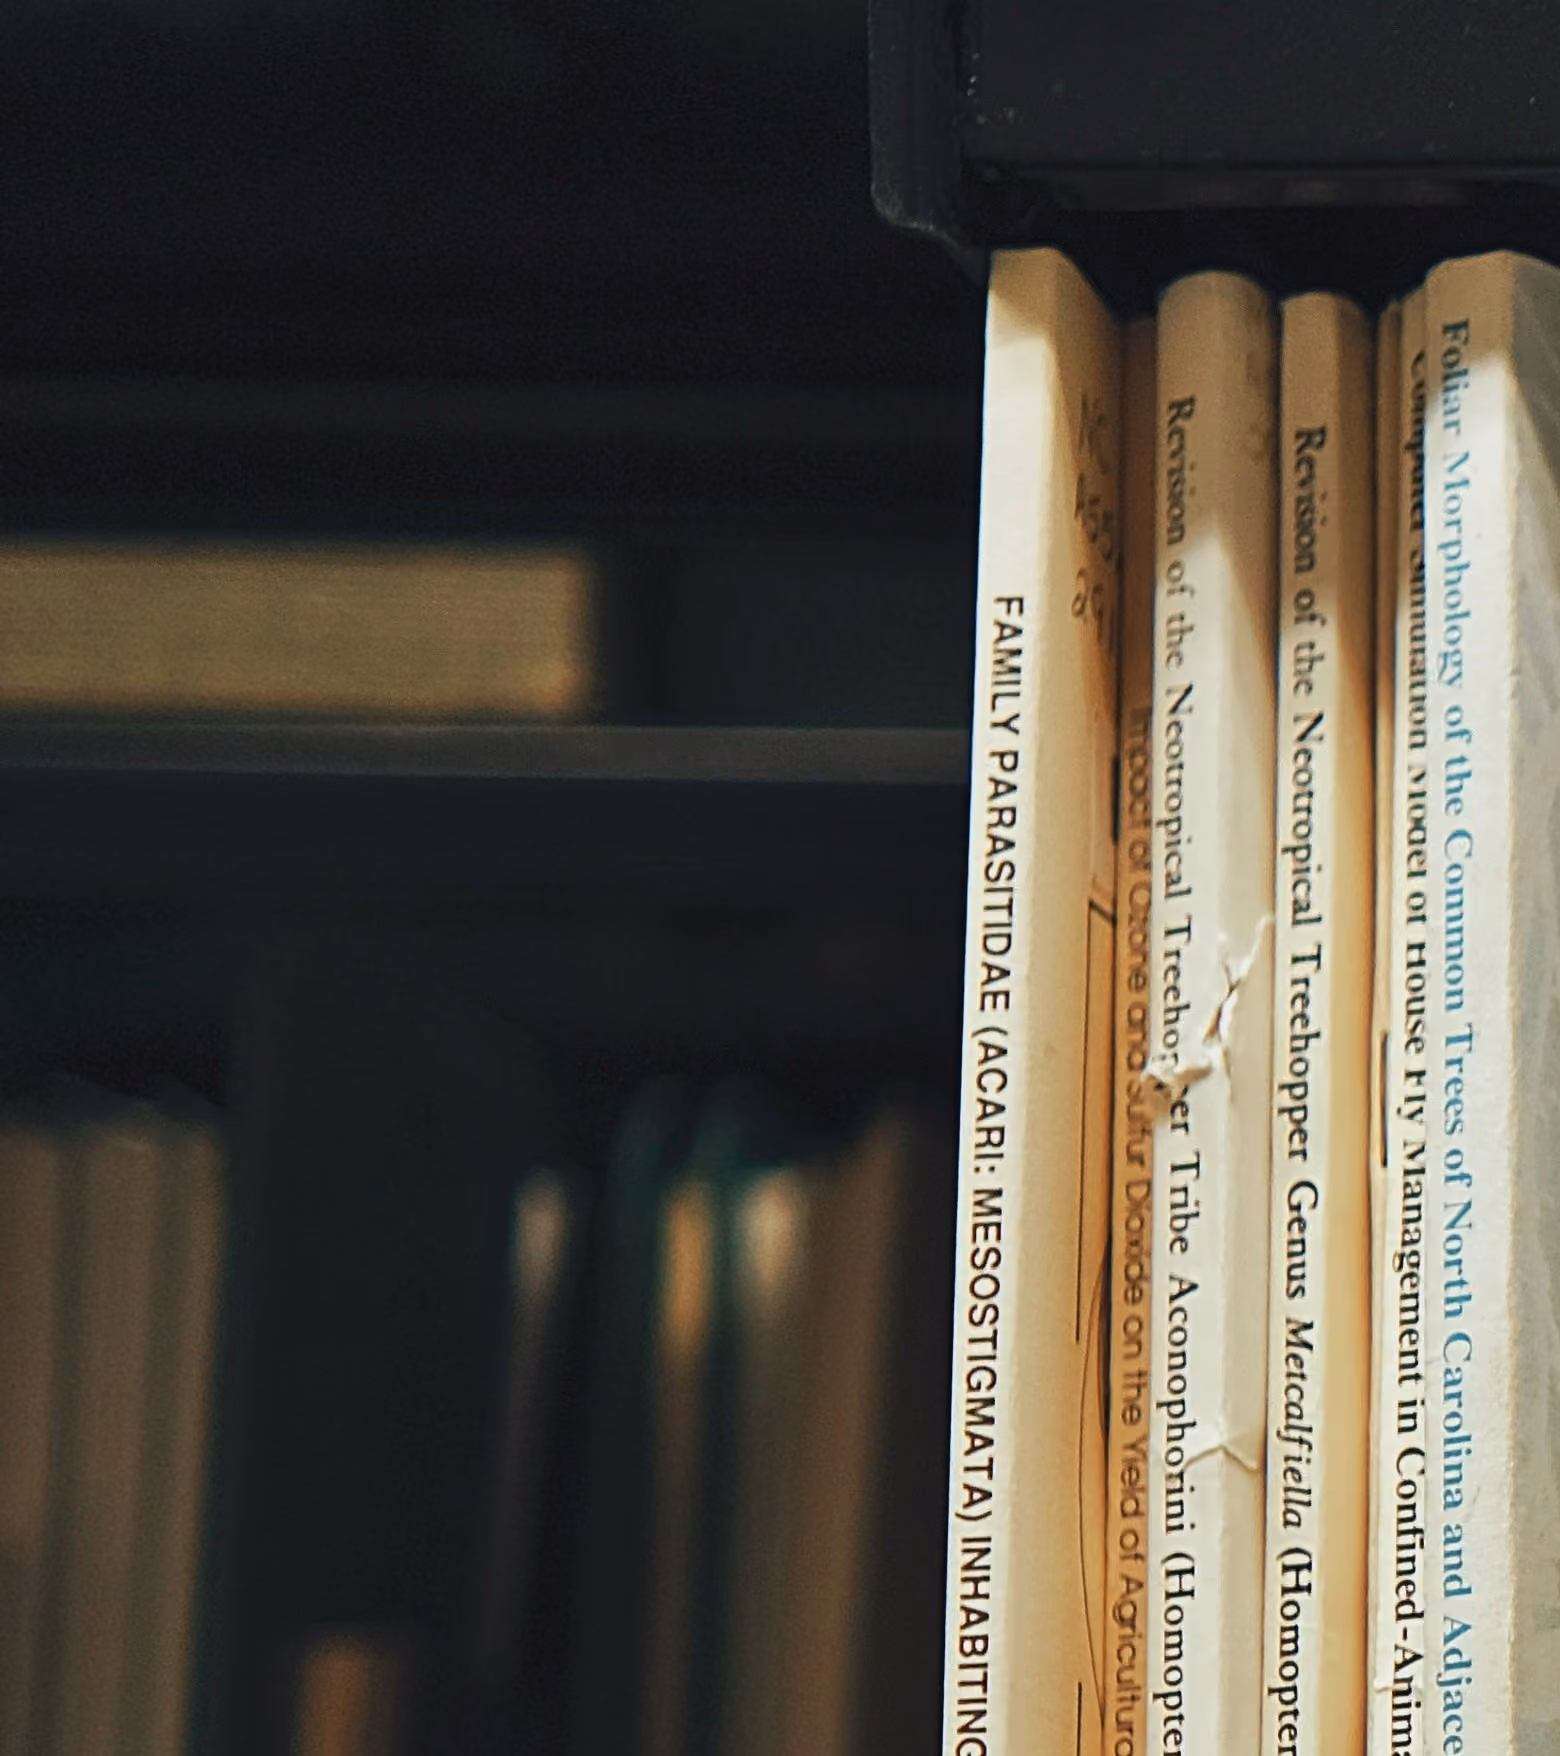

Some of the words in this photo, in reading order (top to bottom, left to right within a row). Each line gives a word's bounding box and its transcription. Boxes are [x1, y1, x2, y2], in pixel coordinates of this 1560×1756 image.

[1438, 319, 1472, 435] Foliar
[1162, 397, 1197, 544] Revision
[1291, 426, 1327, 574] Revision
[1164, 561, 1194, 602] of
[1292, 589, 1324, 628] of
[1436, 451, 1473, 689] Morphology
[988, 596, 1024, 733] FAMILY
[1164, 613, 1193, 668] the
[1292, 640, 1322, 696] the
[1441, 705, 1474, 744] of
[1154, 684, 1194, 899] Neotropical
[1280, 711, 1325, 926] Neotropical
[1443, 756, 1474, 815] the
[978, 750, 1019, 1012] PARASITIDAE
[1441, 828, 1474, 1012] Common
[1276, 944, 1321, 1161] Treehopper
[1403, 940, 1428, 1054] House
[968, 1027, 1010, 1174] (ACARI:
[1441, 1024, 1473, 1136] Trees
[1166, 1148, 1201, 1254] Tribe
[1442, 1148, 1473, 1188] of
[1121, 1180, 1151, 1306] Dioxide
[1284, 1180, 1318, 1299] Genus
[1391, 1139, 1428, 1390] Management
[1441, 1200, 1473, 1319] North
[956, 1188, 1003, 1522] MESOSTIGMATA)
[1120, 1317, 1146, 1362] on
[1120, 1370, 1148, 1425] the
[1153, 1275, 1201, 1534] Aconophorini
[1279, 1317, 1317, 1528] Metcalfiella
[1394, 1398, 1425, 1434] in
[1440, 1332, 1473, 1511] Carolina
[1117, 1436, 1147, 1520] Yield
[1117, 1530, 1145, 1562] of
[1440, 1523, 1473, 1598] and
